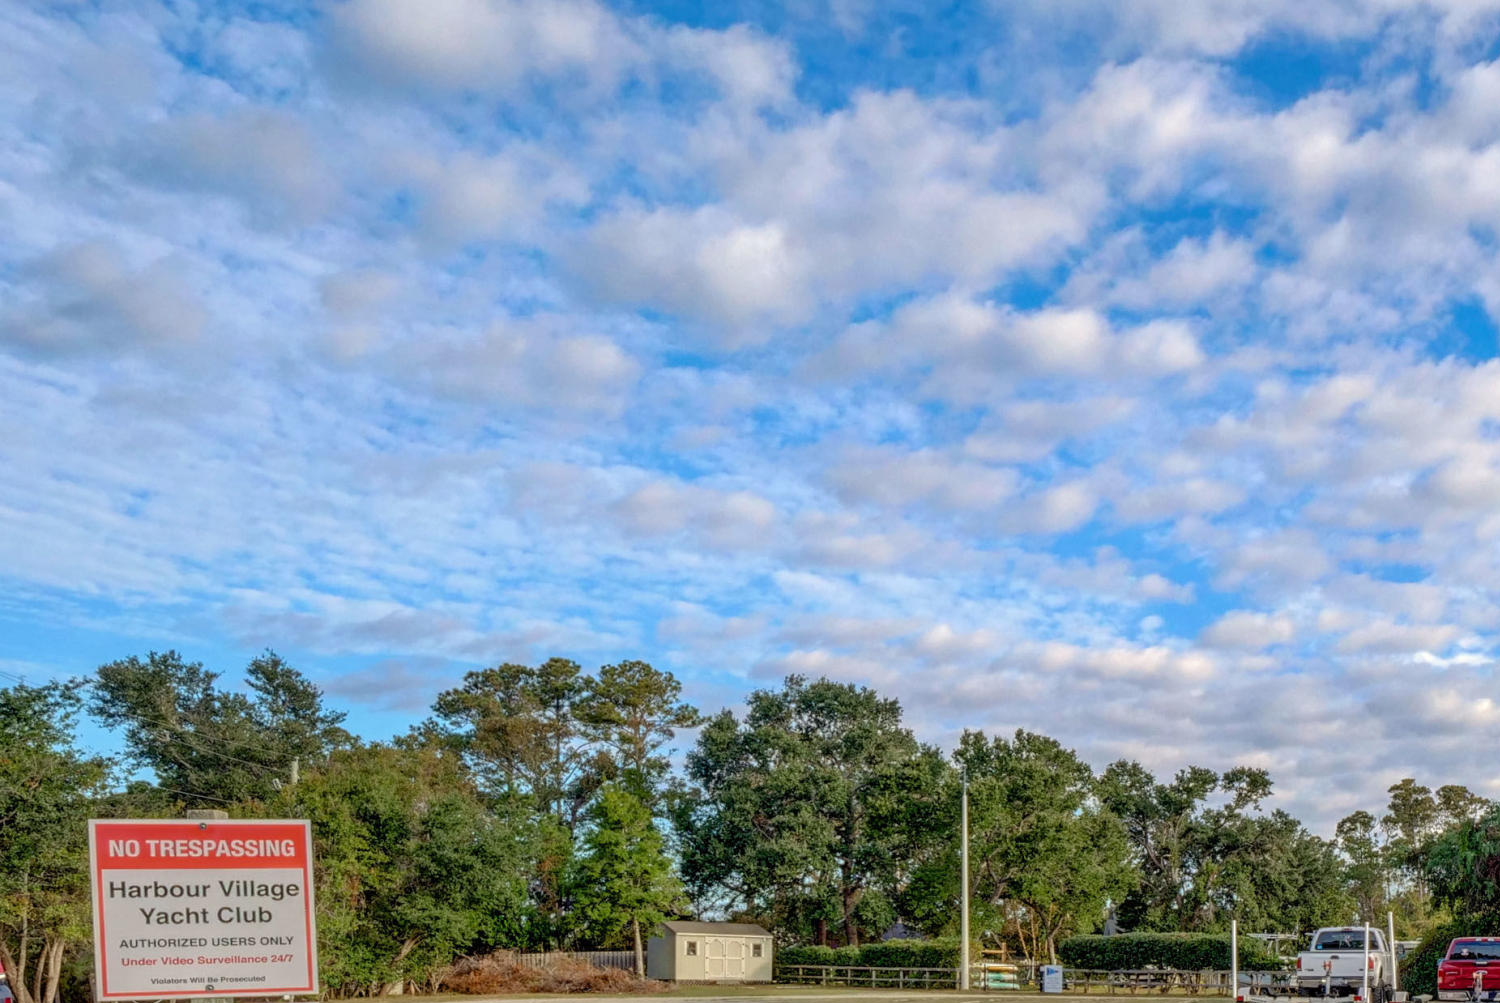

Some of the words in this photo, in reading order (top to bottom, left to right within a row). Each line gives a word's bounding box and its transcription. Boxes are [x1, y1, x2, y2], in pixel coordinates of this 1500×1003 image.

[108, 839, 140, 858] NO
[146, 839, 295, 857] TRESPASSING
[109, 881, 210, 898] Harbour
[218, 880, 300, 900] Village
[140, 907, 209, 924] Yacht
[217, 906, 272, 923] Club
[120, 938, 208, 948] AUTHORIZED
[212, 937, 256, 947] USERS
[260, 936, 294, 946] ONLY
[121, 957, 157, 966] Under
[161, 956, 194, 966] Video
[198, 954, 268, 964] Surveillance
[271, 954, 294, 963] 24/7
[190, 976, 204, 984] Will
[220, 975, 266, 983] Prosecuted
